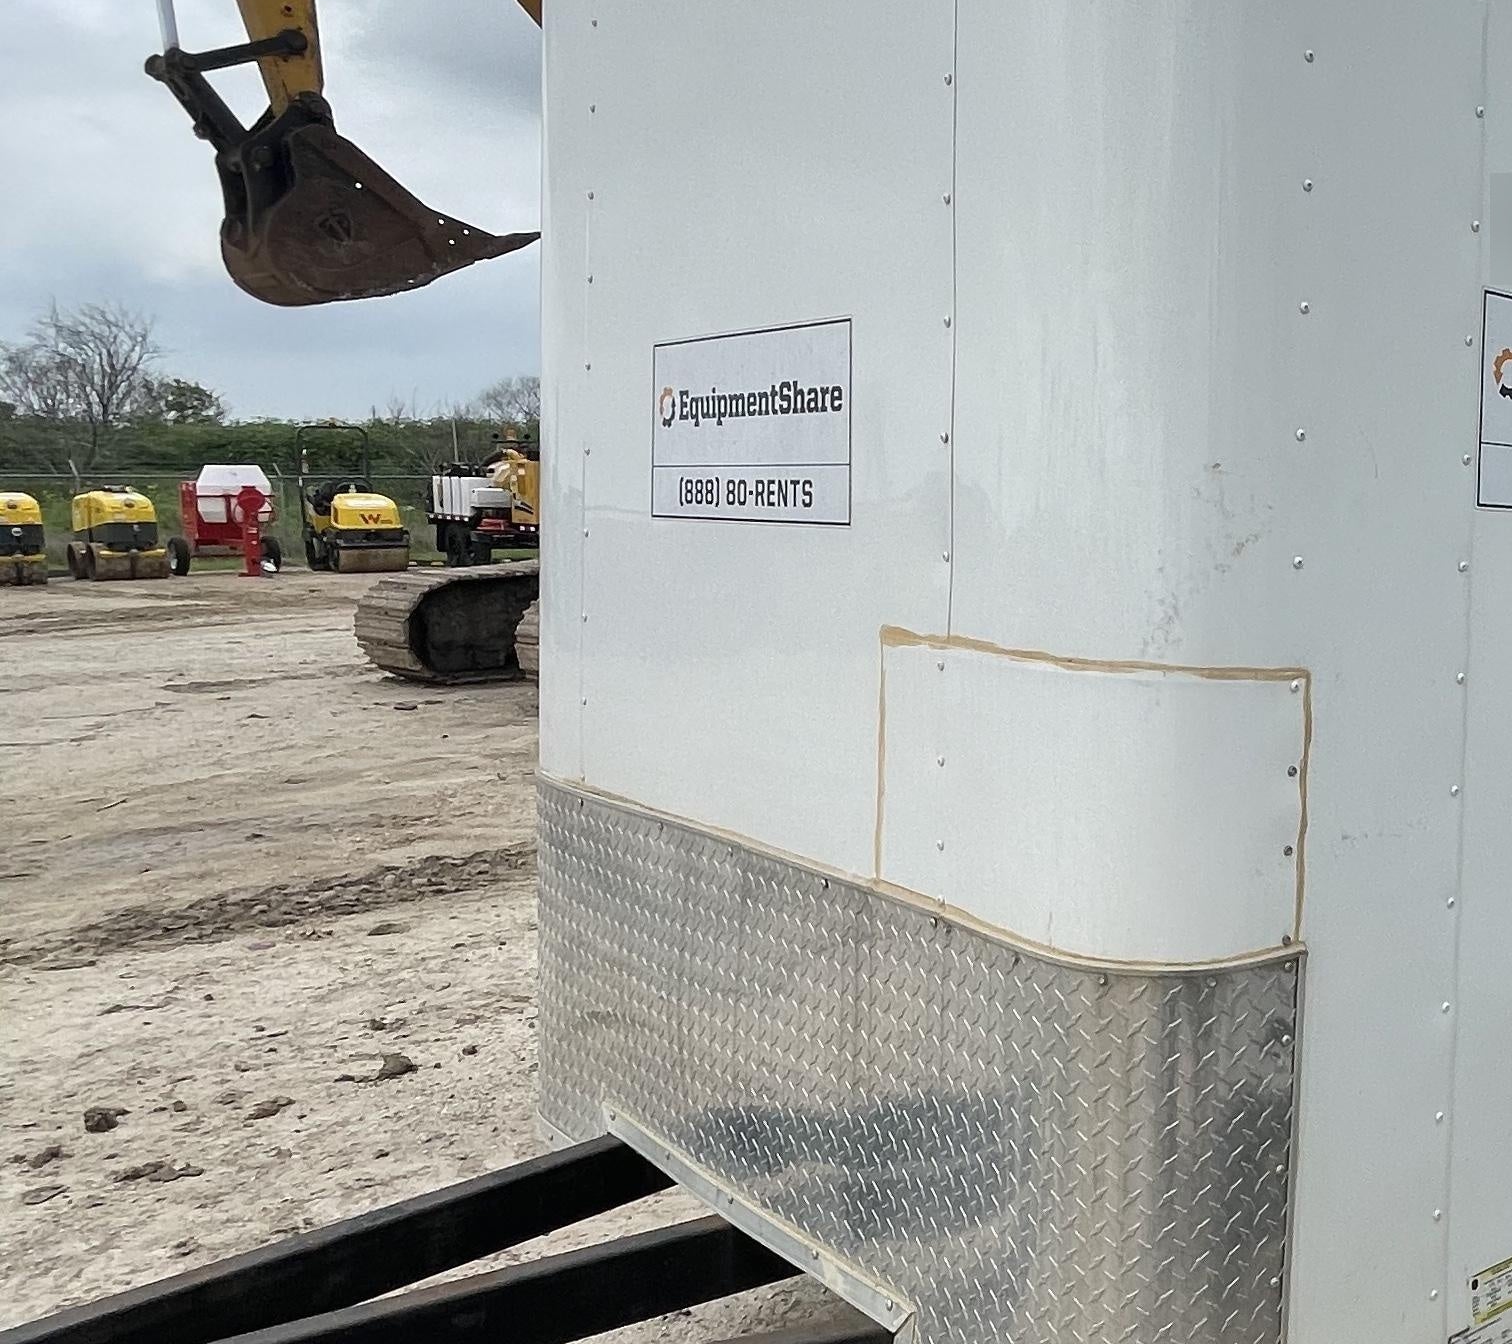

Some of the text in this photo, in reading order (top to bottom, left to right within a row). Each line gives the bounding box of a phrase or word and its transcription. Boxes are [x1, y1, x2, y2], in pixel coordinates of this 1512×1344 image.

[678, 380, 843, 427] EquipmentShare
[679, 476, 813, 508] (888) 80-RENTS
